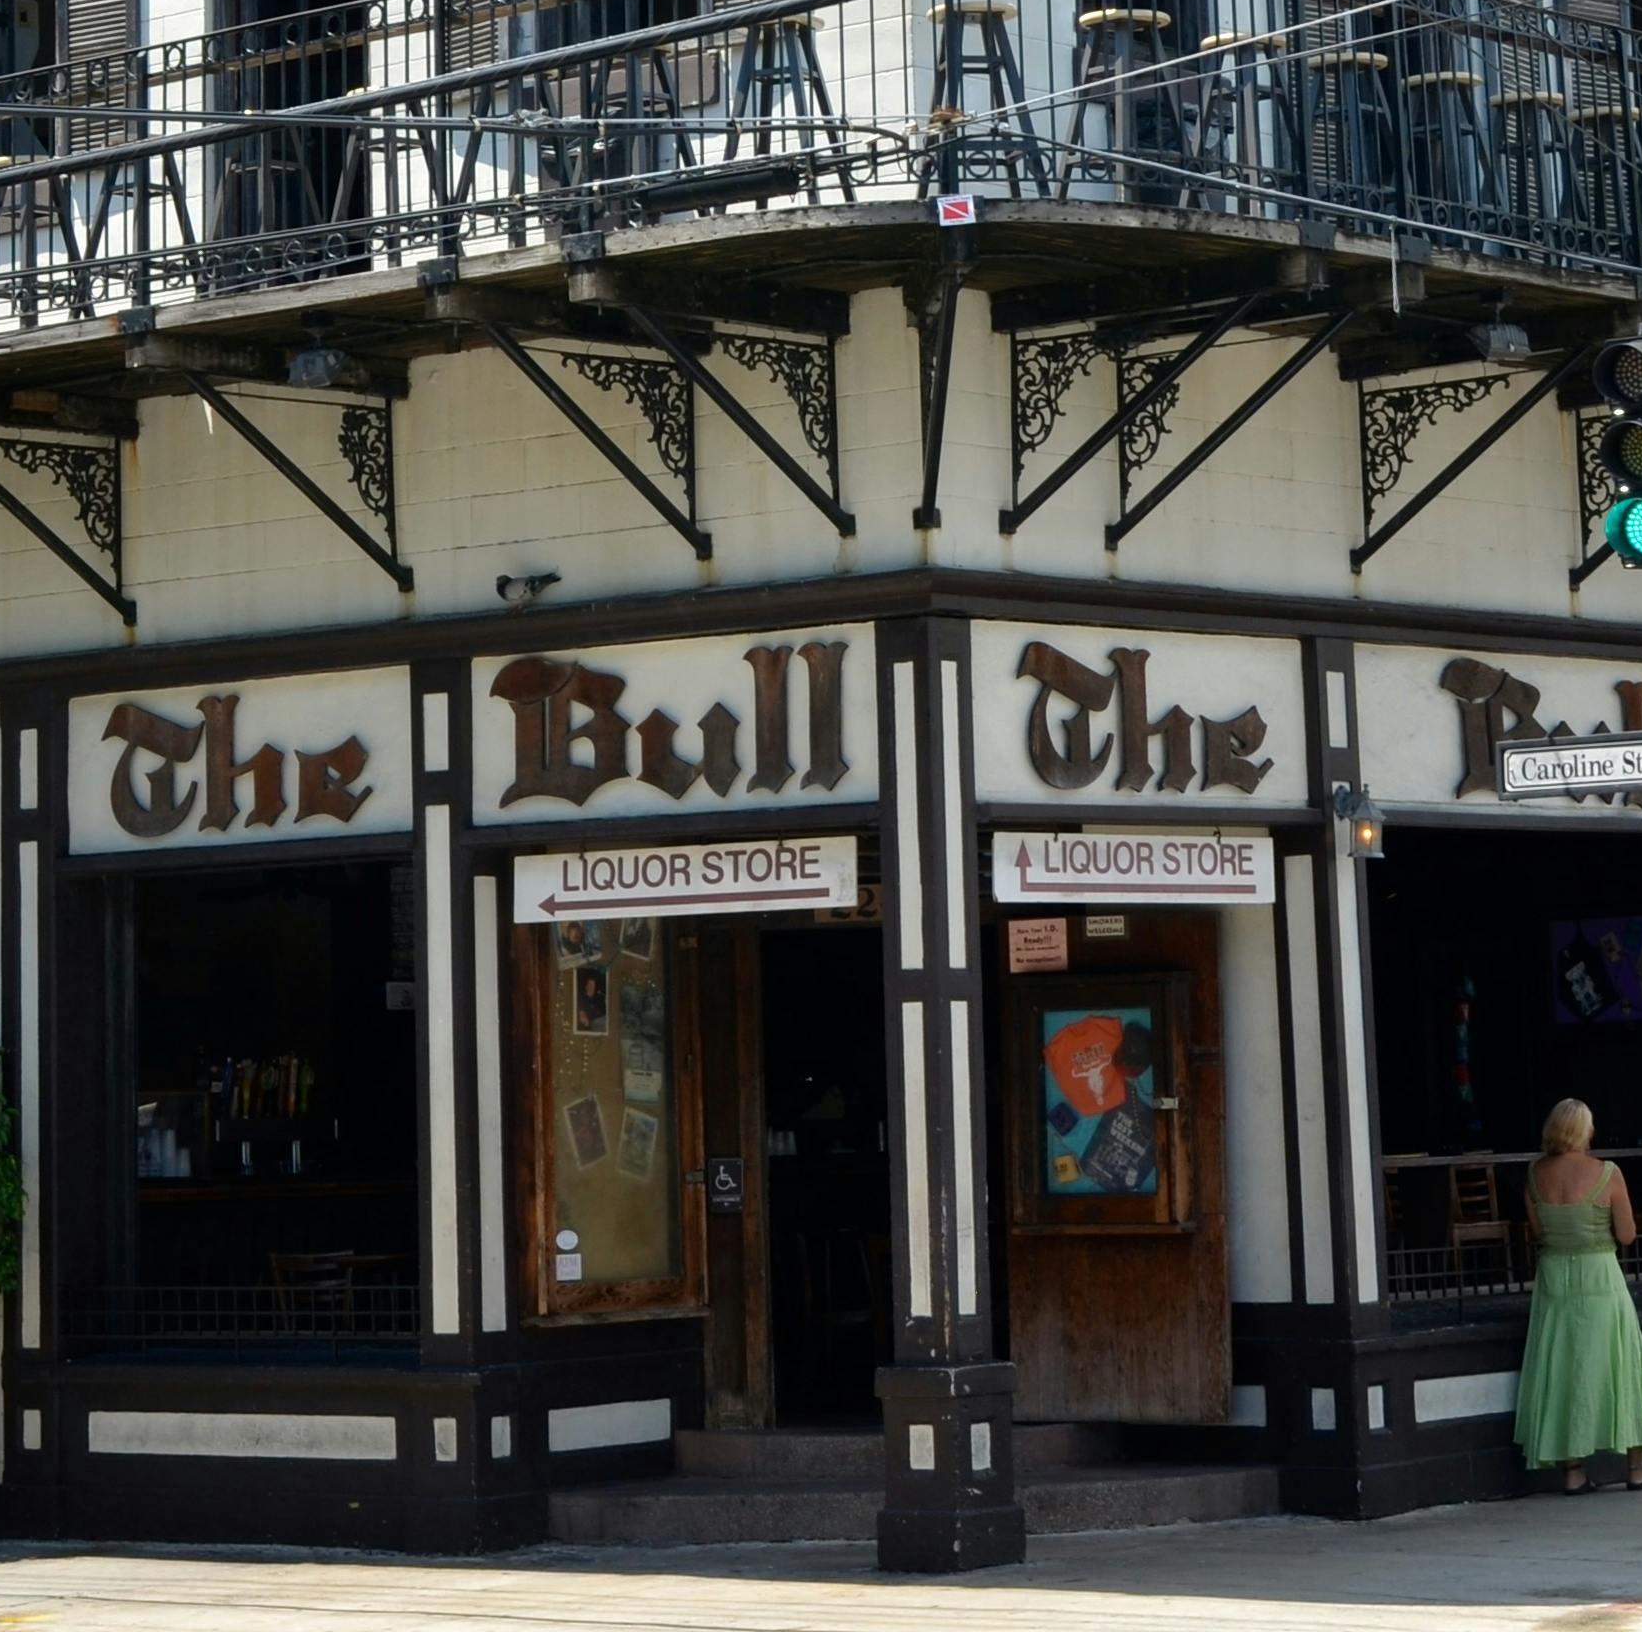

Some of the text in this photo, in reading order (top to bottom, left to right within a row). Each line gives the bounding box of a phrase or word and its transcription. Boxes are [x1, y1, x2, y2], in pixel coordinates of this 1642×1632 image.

[102, 640, 850, 839] The Bull
[1016, 641, 1274, 794] The
[1520, 751, 1616, 781] Caroline
[561, 847, 822, 893] LIQUOR STORE
[1042, 841, 1255, 877] LIQUOR STORE
